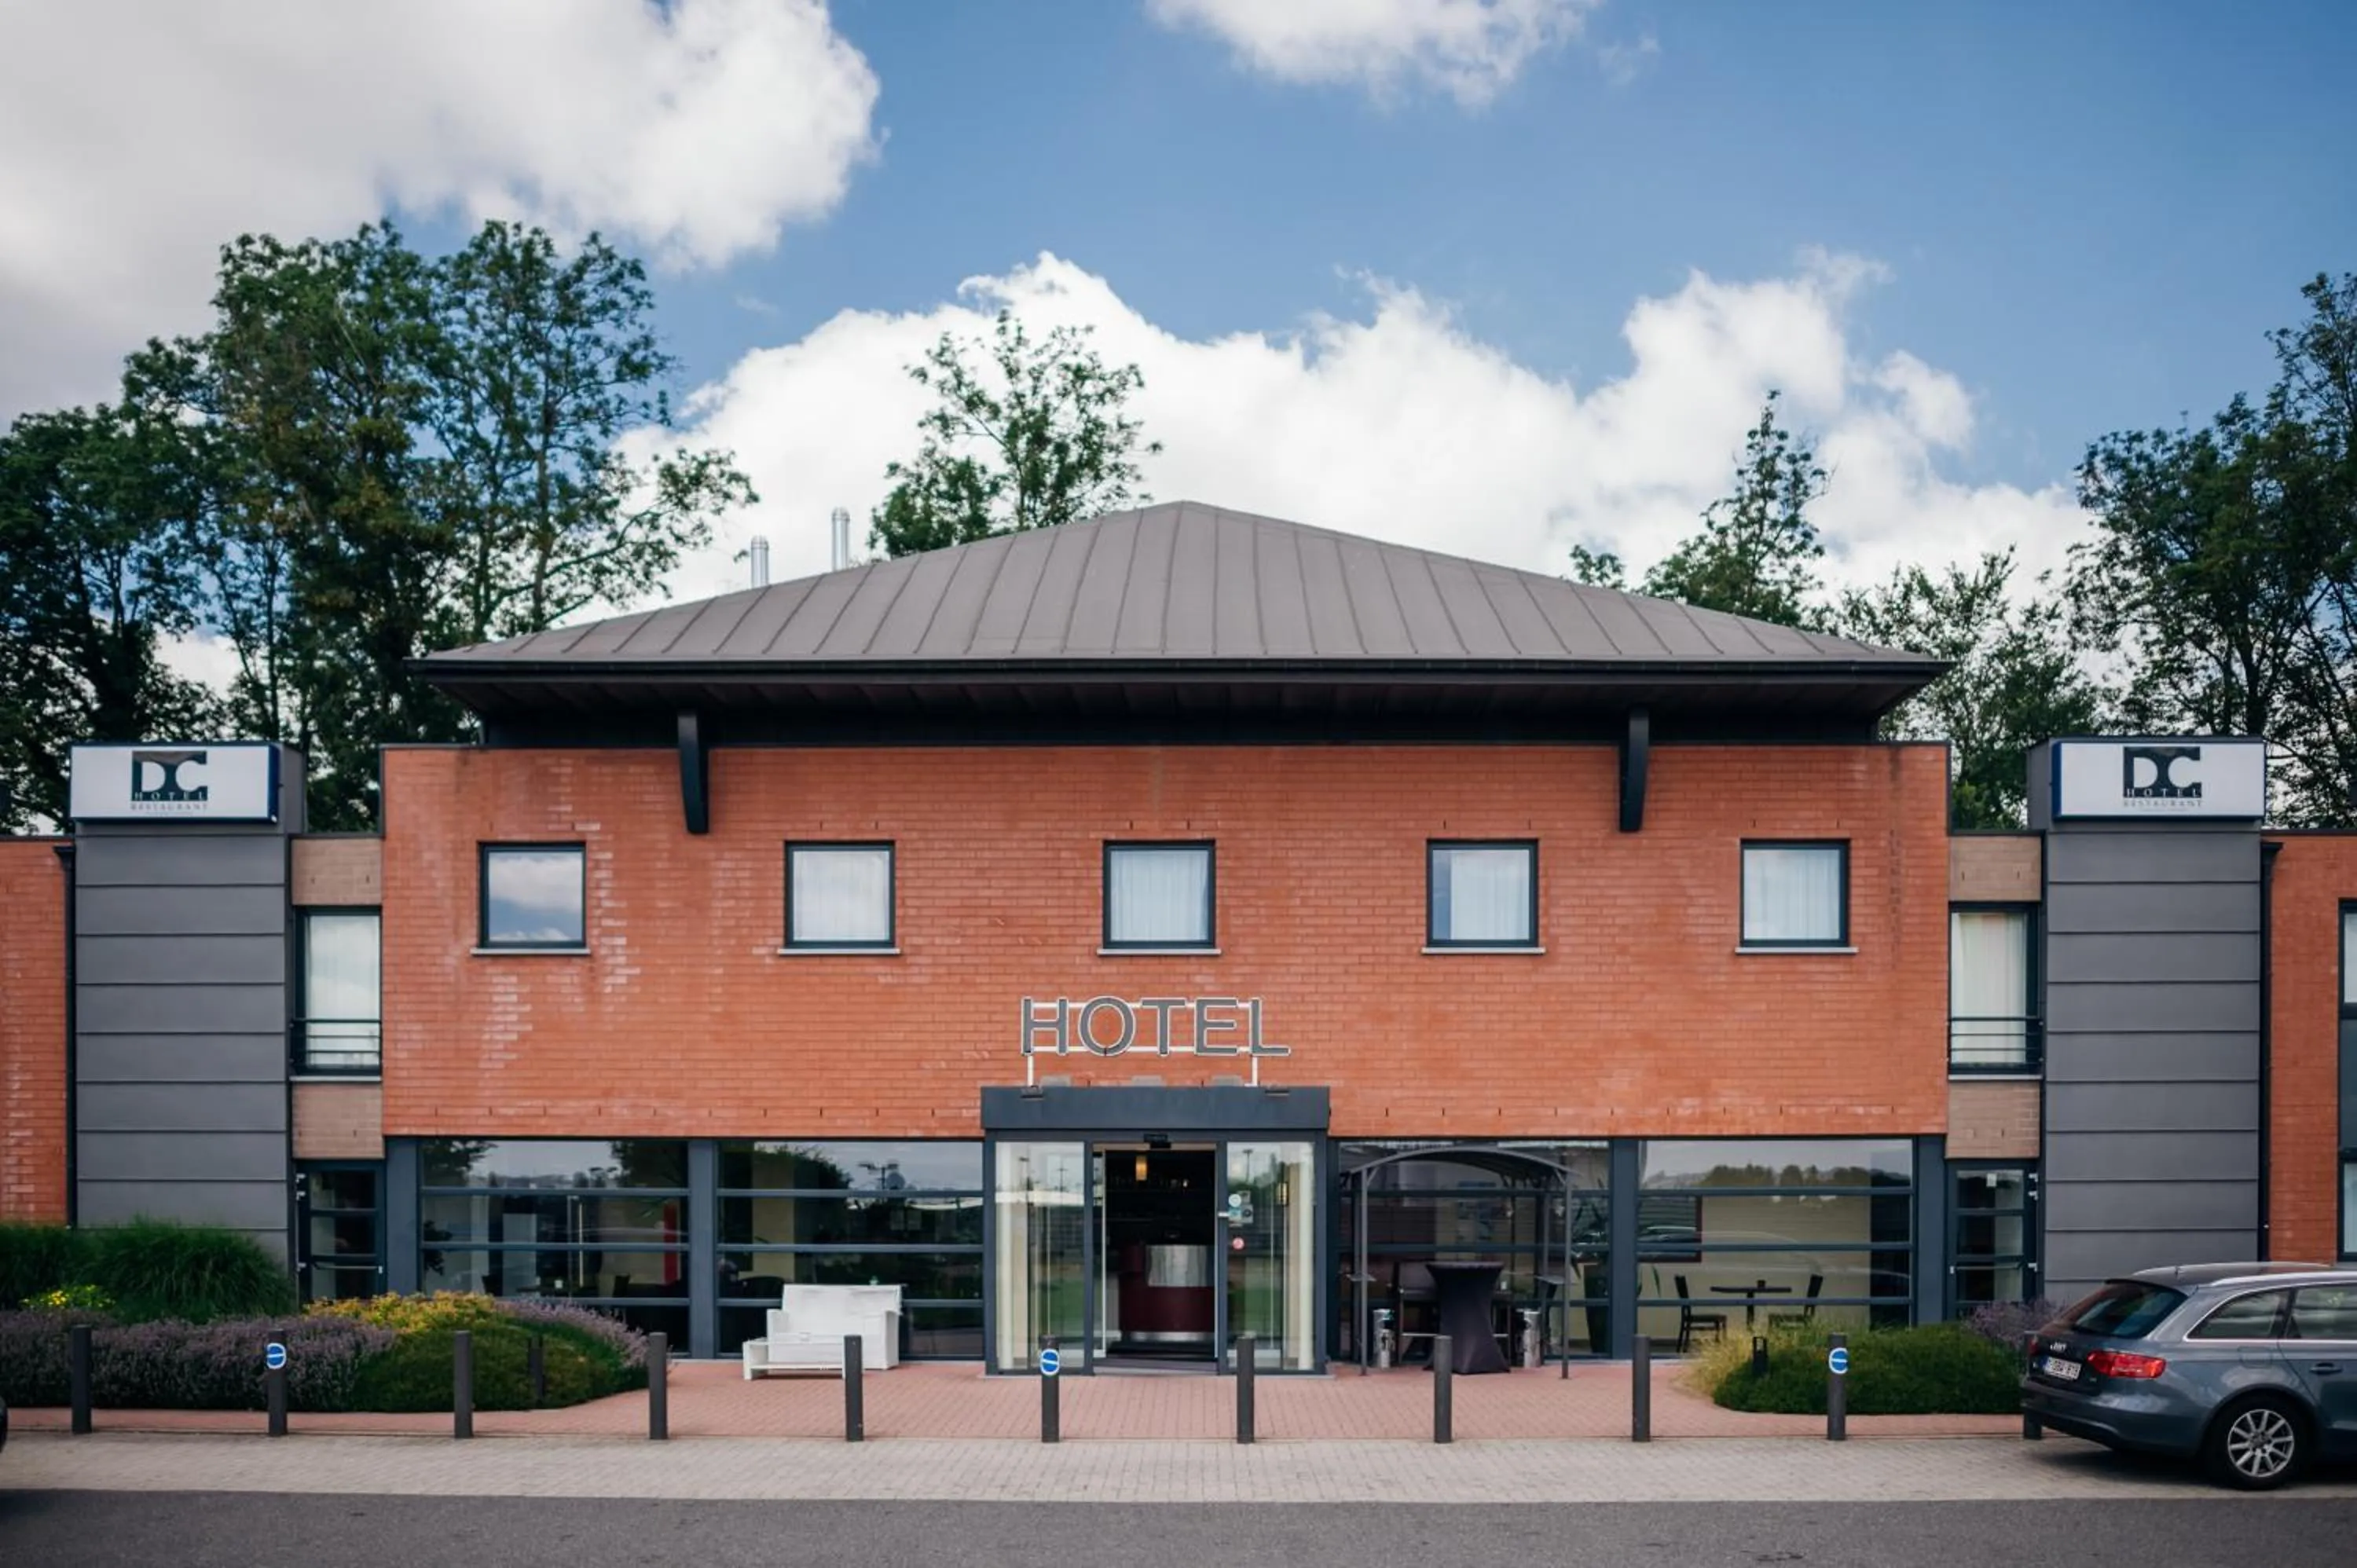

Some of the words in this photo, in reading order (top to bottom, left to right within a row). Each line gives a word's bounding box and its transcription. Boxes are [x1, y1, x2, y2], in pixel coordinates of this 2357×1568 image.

[134, 792, 204, 800] HOTEL
[2127, 788, 2200, 797] HOTEL
[1021, 995, 1291, 1057] HOTEL
